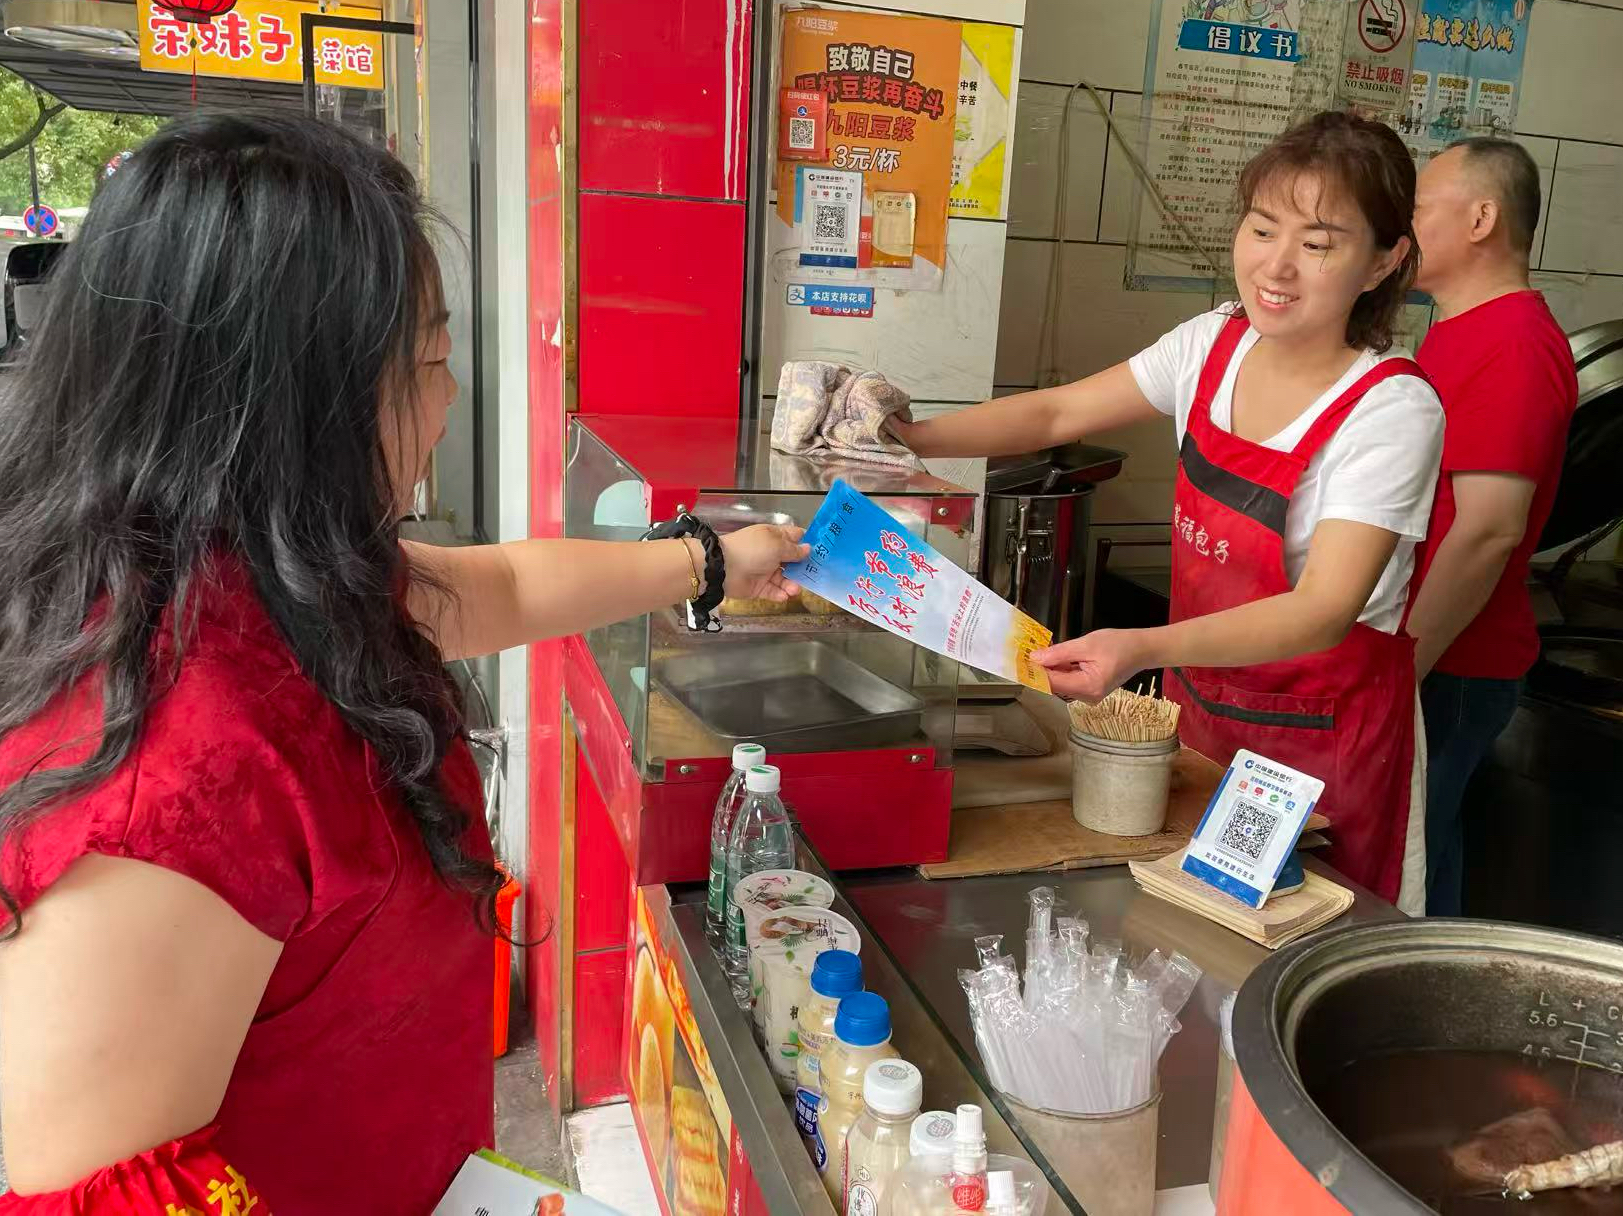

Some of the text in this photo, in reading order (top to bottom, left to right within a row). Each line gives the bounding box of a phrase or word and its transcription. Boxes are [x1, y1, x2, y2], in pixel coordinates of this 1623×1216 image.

[151, 4, 293, 62] 荣妹子
[1207, 26, 1292, 57] 倡议书
[828, 45, 913, 78] 致敬自己
[1345, 61, 1405, 85] 禁止吸烟
[1344, 80, 1357, 88] NO
[1359, 81, 1401, 94] SMOKING
[826, 110, 917, 141] 九阳豆浆
[832, 145, 901, 173] 3元/杯
[811, 291, 867, 304] 本店支持花呗
[848, 529, 908, 618] 厉行节约
[882, 552, 942, 634] 反对浪费
[1540, 992, 1549, 1006] L
[1529, 1010, 1558, 1027] 5.6
